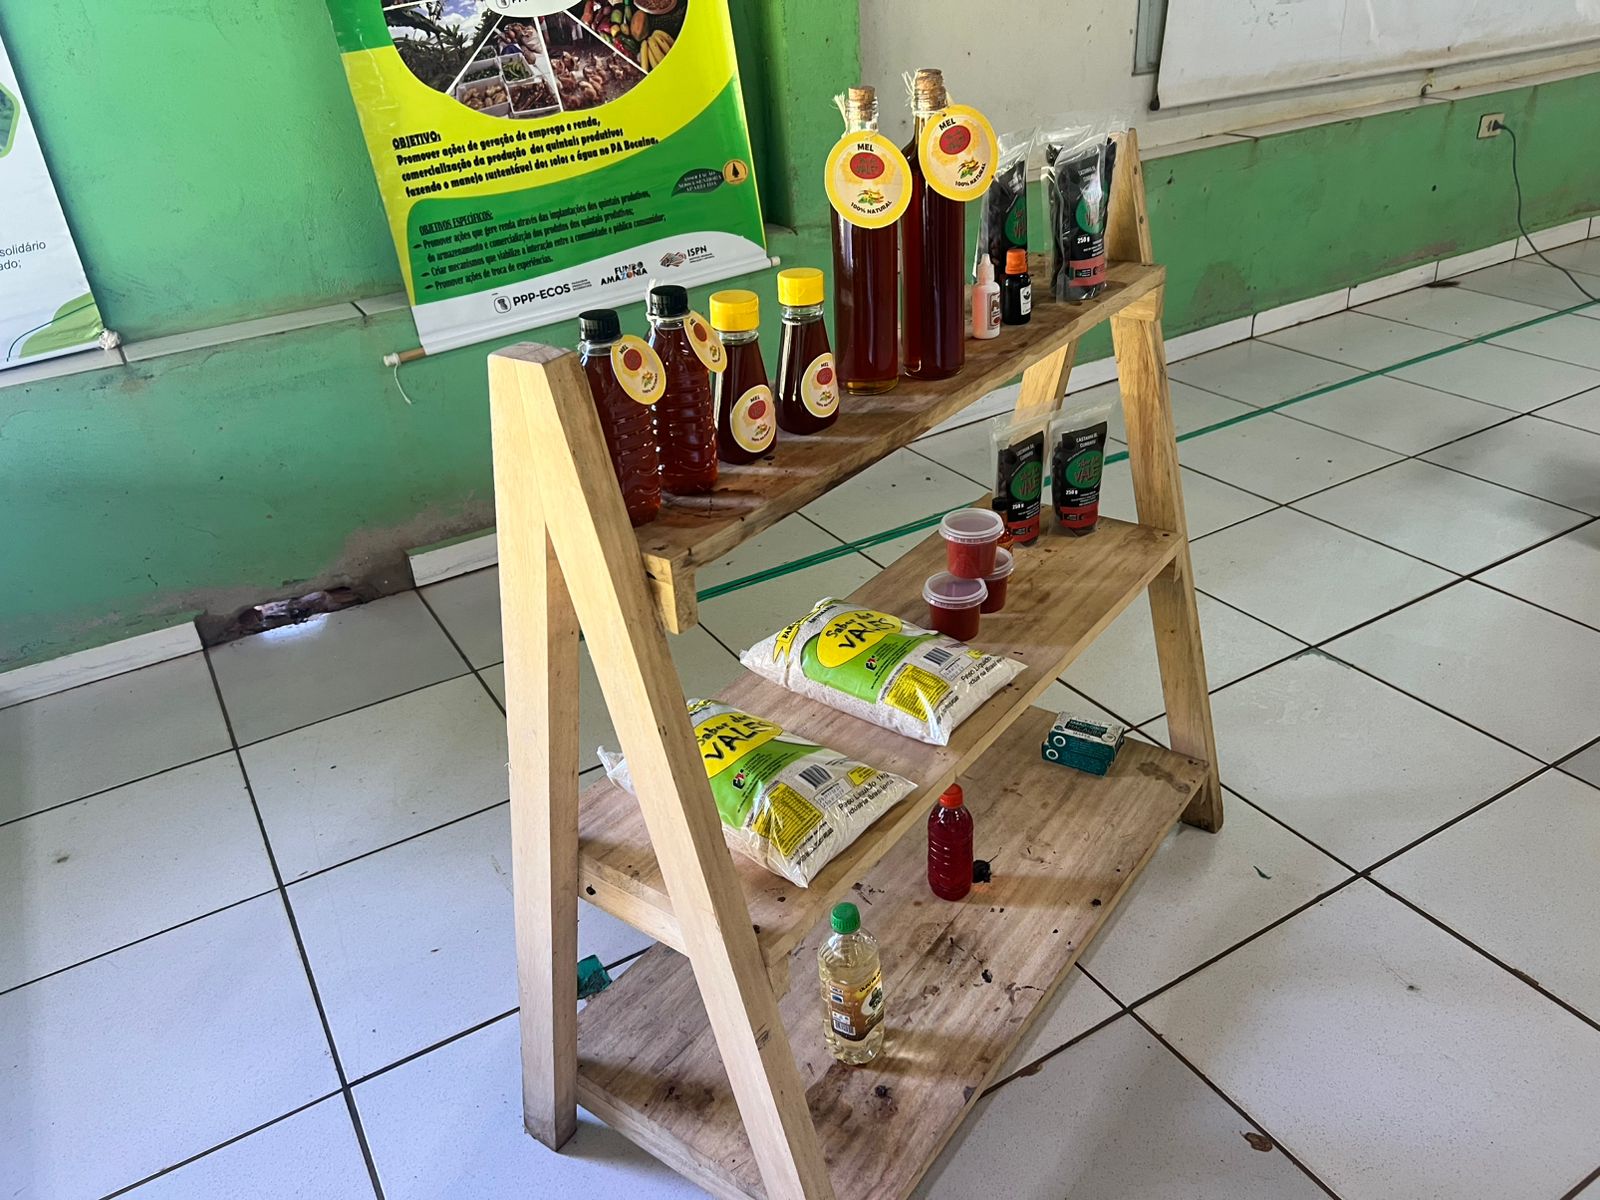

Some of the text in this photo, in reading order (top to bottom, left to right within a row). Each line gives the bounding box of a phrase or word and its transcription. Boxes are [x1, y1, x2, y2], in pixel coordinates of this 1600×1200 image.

[939, 118, 956, 131] MEL
[392, 130, 441, 151] OBJETIVO:
[396, 116, 601, 166] Promover ações de geração de emprego e renda,
[857, 143, 874, 152] MEL
[402, 128, 624, 182] comercialização da produção dos quintais produtivos
[406, 181, 442, 198] fazendo
[443, 181, 449, 190] o
[450, 172, 484, 188] manejo
[485, 161, 533, 182] sustentável
[534, 159, 549, 170] dos
[550, 155, 569, 167] solos
[570, 153, 576, 162] e
[577, 149, 598, 162] água
[599, 146, 610, 157] no
[610, 142, 624, 154] PA
[970, 163, 986, 186] NATURAL
[850, 200, 892, 214] 100% NATURAL
[419, 219, 452, 236] OBJETIVOS
[0, 240, 46, 257] solidário
[423, 236, 453, 249] Promover
[472, 228, 483, 239] que
[687, 245, 707, 257] ISPN
[513, 283, 571, 306] PPP-ECOS
[826, 619, 856, 638] Sabor
[838, 618, 896, 648] VALES
